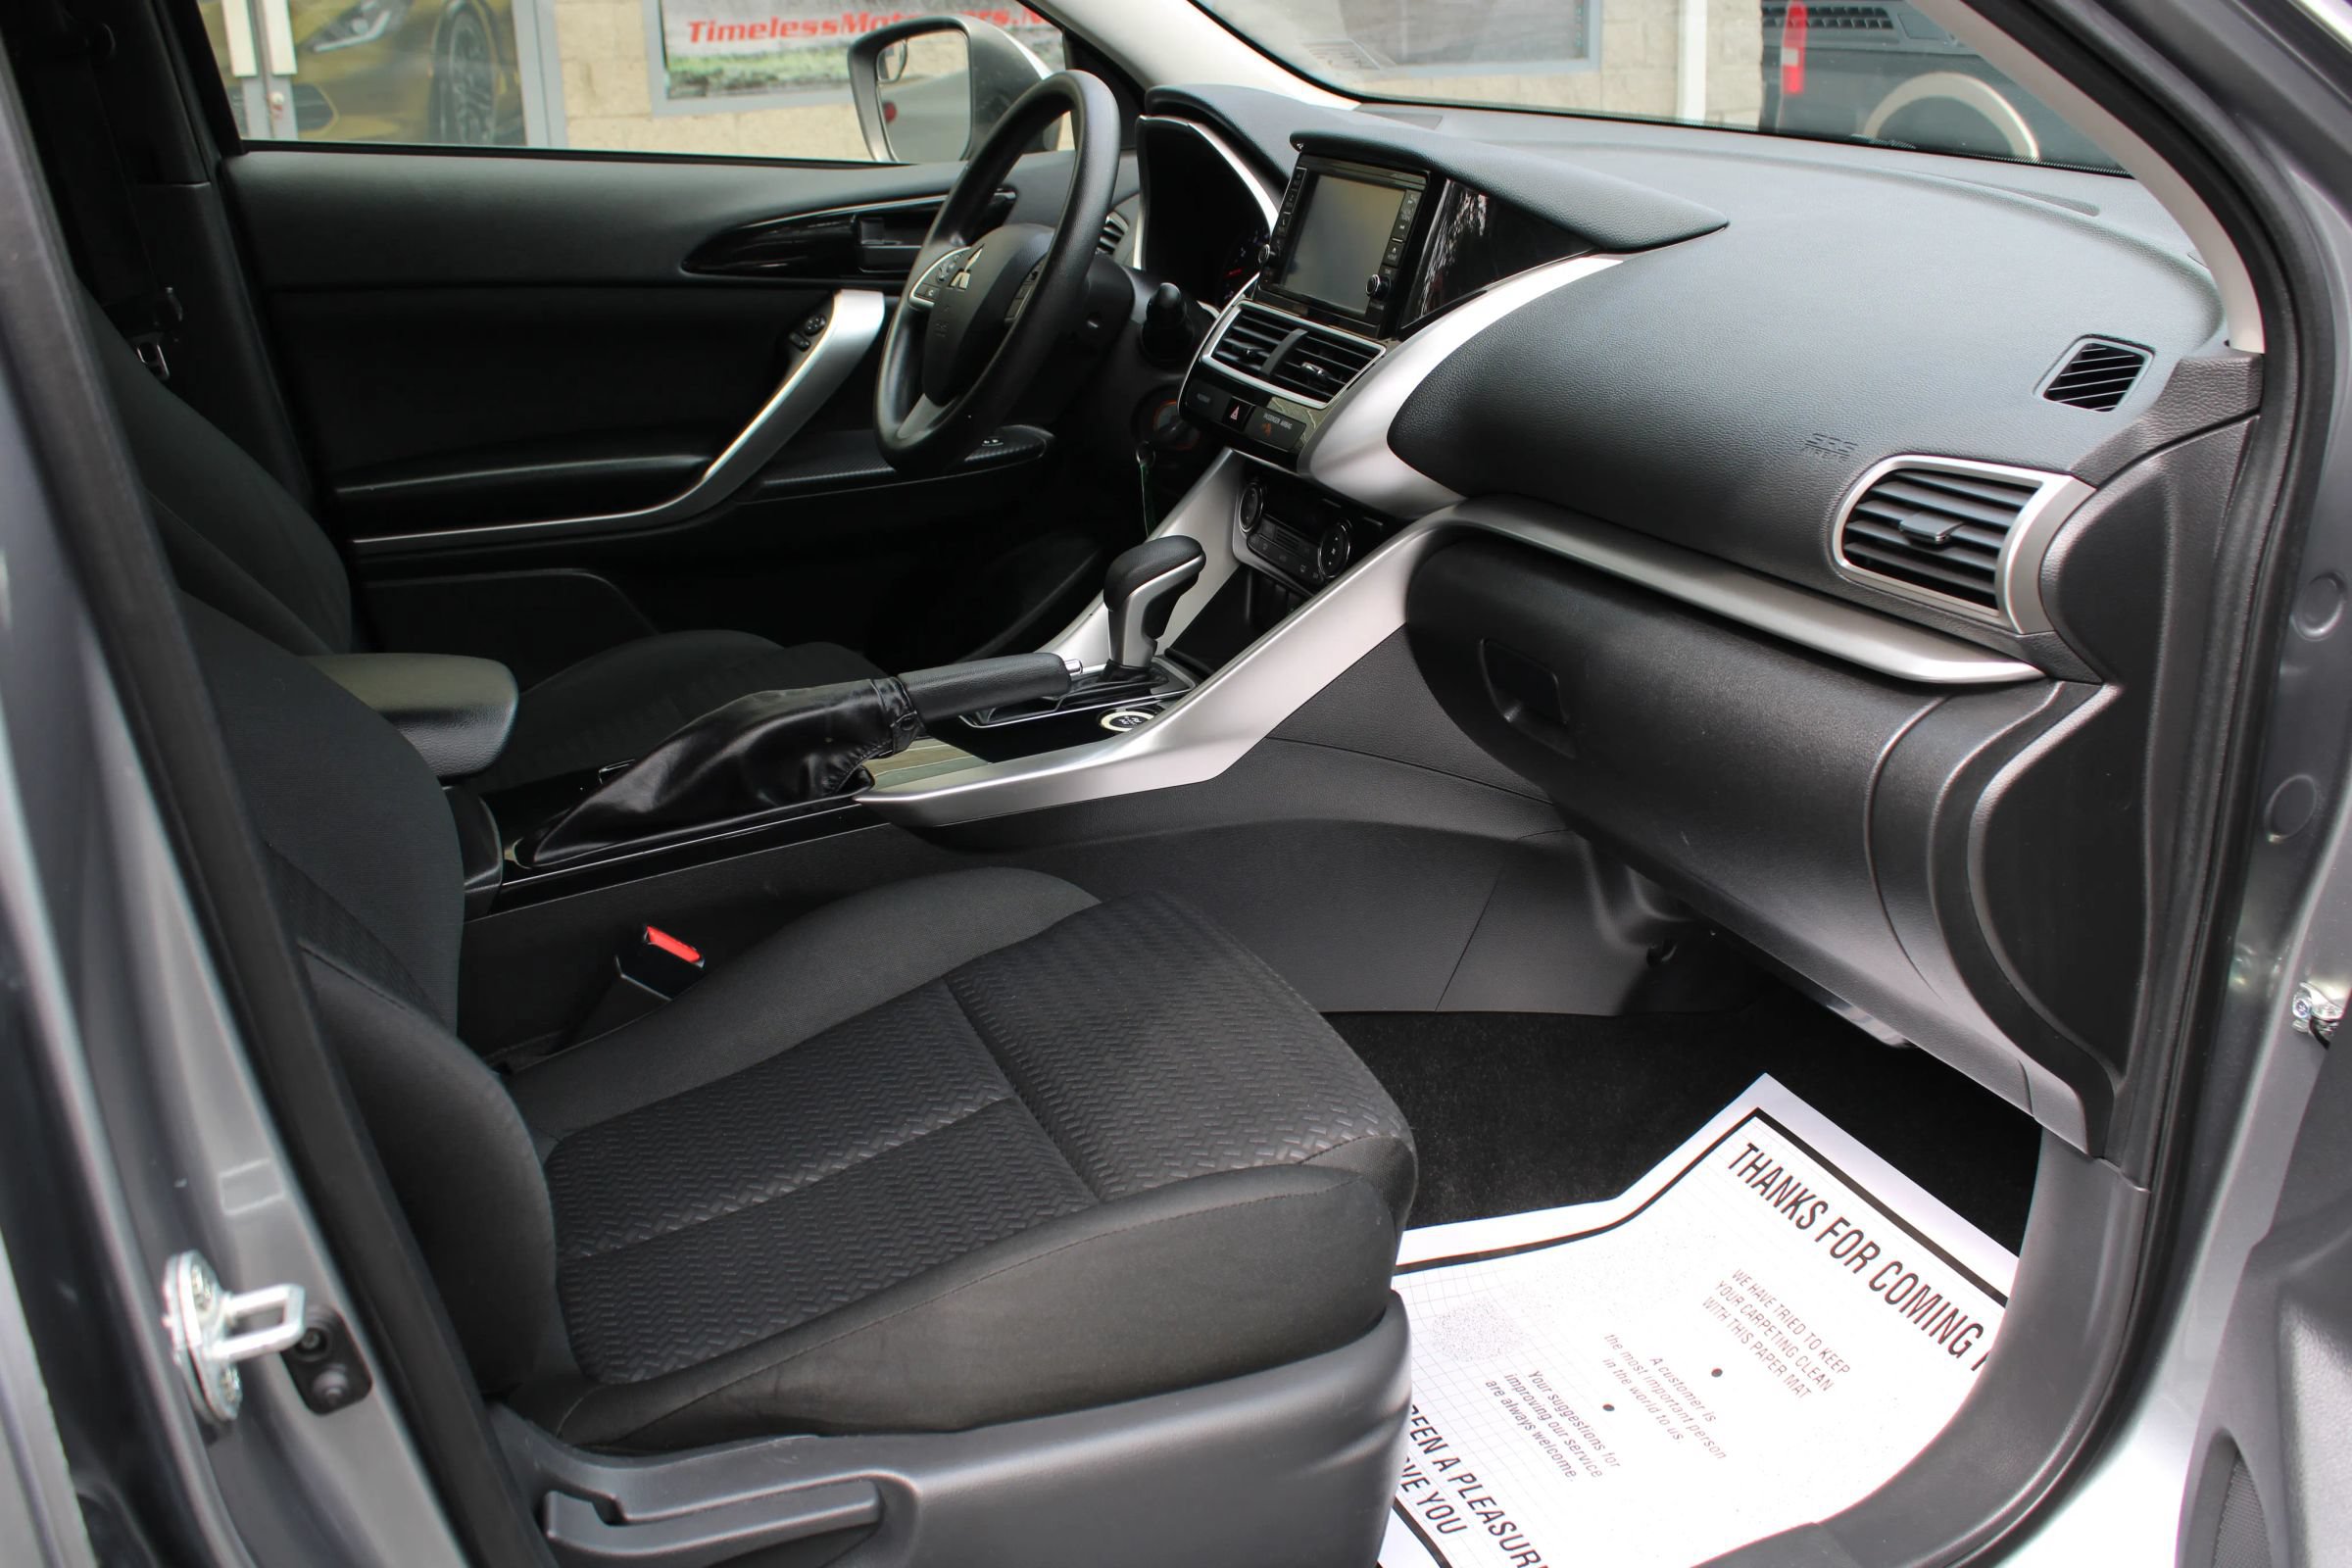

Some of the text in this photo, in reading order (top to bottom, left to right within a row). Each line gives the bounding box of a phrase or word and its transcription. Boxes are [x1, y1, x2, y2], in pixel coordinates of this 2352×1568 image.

[1728, 1142, 1984, 1359] THANKS FOR COMING
[1702, 1297, 1812, 1398] WITH THIS PAPER MAT
[1715, 1280, 1835, 1392] YOUR CARPETING CLEAN
[1732, 1268, 1851, 1374] WE HAVE TRIED TO KEEP
[1485, 1380, 1577, 1482] are always welcome.
[1503, 1373, 1603, 1478] improving our service
[1528, 1370, 1621, 1467] Your suggestions for
[1602, 1357, 1616, 1369] in
[1613, 1369, 1632, 1386] the
[1629, 1386, 1663, 1413] world
[1656, 1414, 1670, 1426] to
[1604, 1334, 1727, 1459] the most important person
[1649, 1357, 1717, 1423] A customer is
[1416, 1491, 1468, 1534] YOU
[1432, 1456, 1461, 1472] A
[1447, 1472, 1548, 1568] PLEASUR
